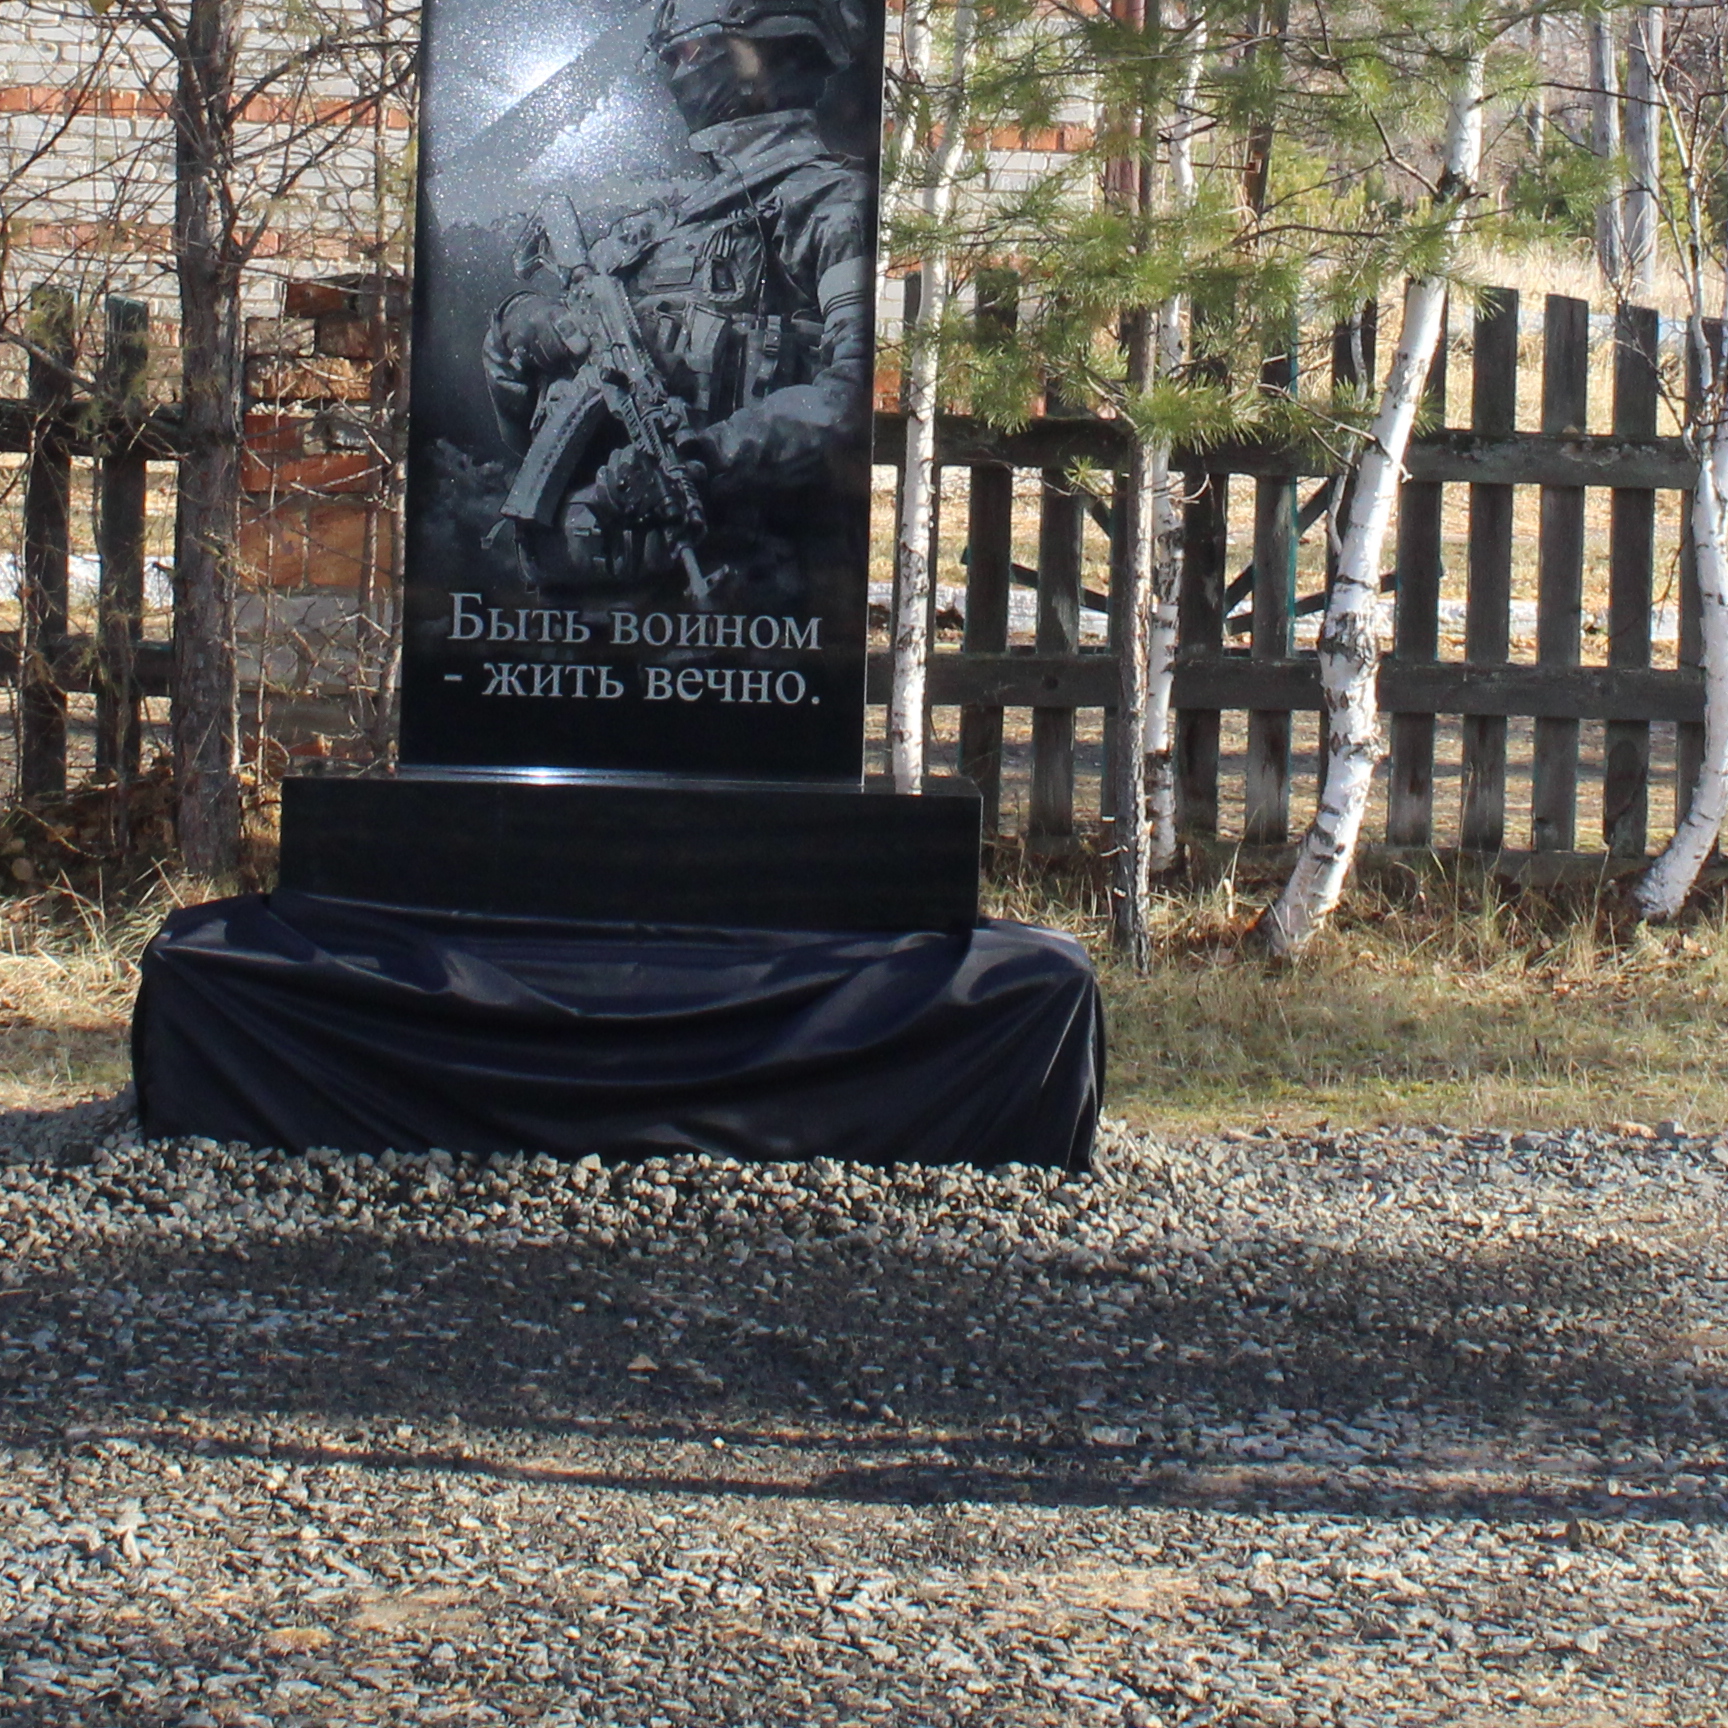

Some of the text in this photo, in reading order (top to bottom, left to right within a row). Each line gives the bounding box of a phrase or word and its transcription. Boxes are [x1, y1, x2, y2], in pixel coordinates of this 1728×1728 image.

[447, 591, 822, 650] Быть воином
[481, 662, 624, 699] жить
[643, 666, 821, 705] вечно.
